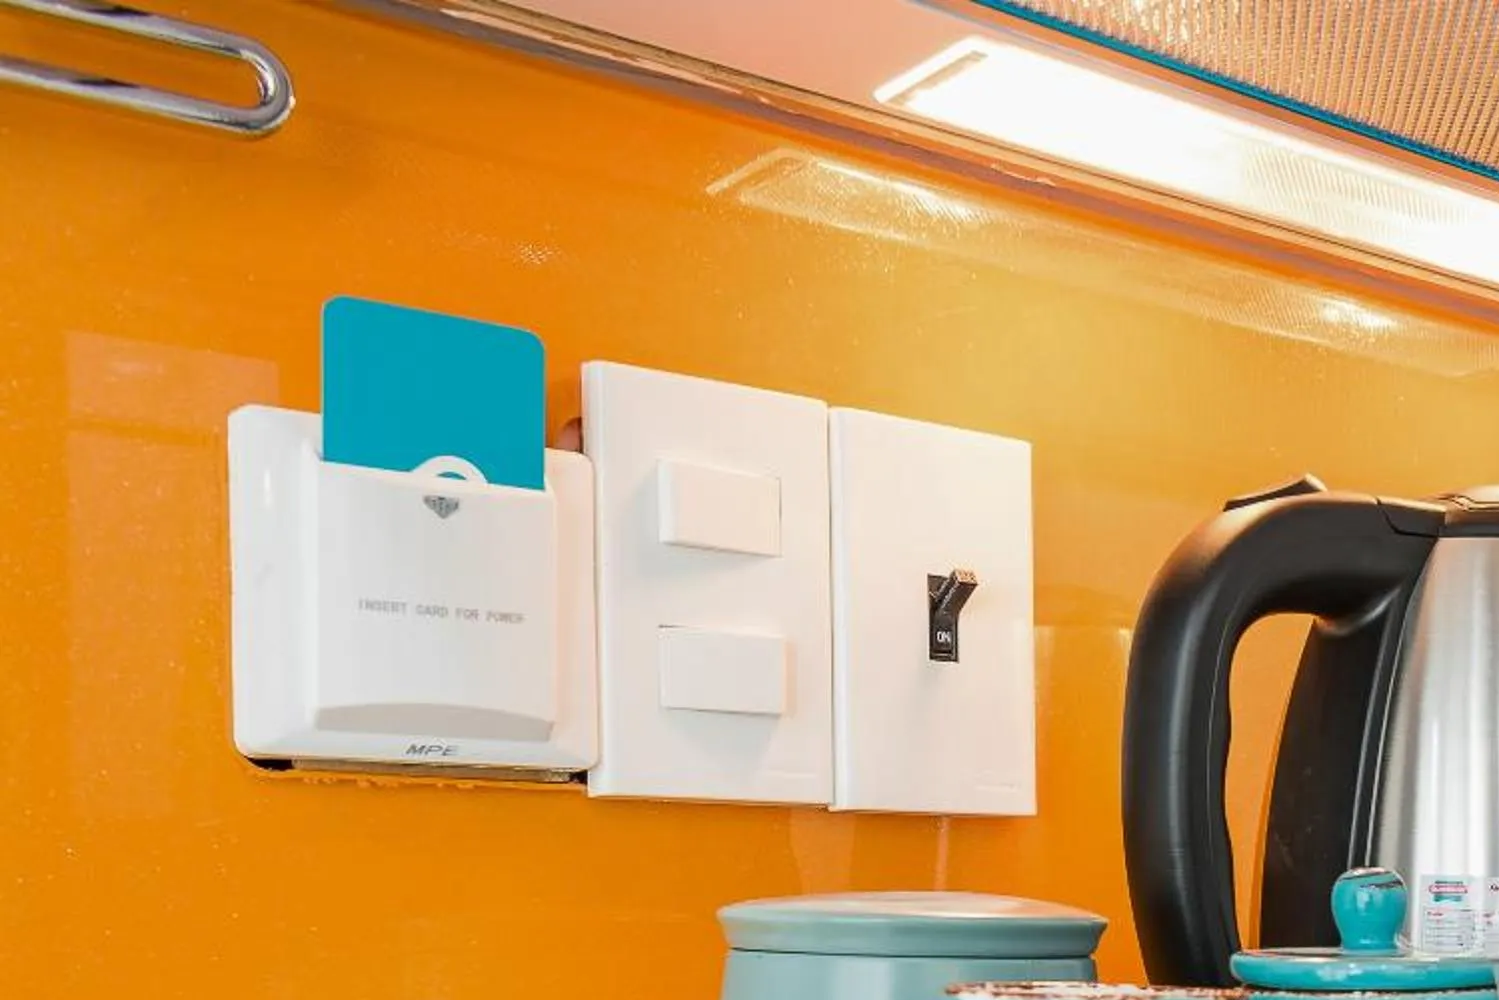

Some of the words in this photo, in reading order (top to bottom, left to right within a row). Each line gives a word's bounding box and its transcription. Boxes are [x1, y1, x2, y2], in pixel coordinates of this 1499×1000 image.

[358, 598, 407, 615] INSERT
[415, 604, 449, 618] CARD
[455, 607, 479, 620] FOR
[486, 610, 526, 624] POWER
[936, 630, 952, 643] ON
[405, 744, 459, 757] MPE
